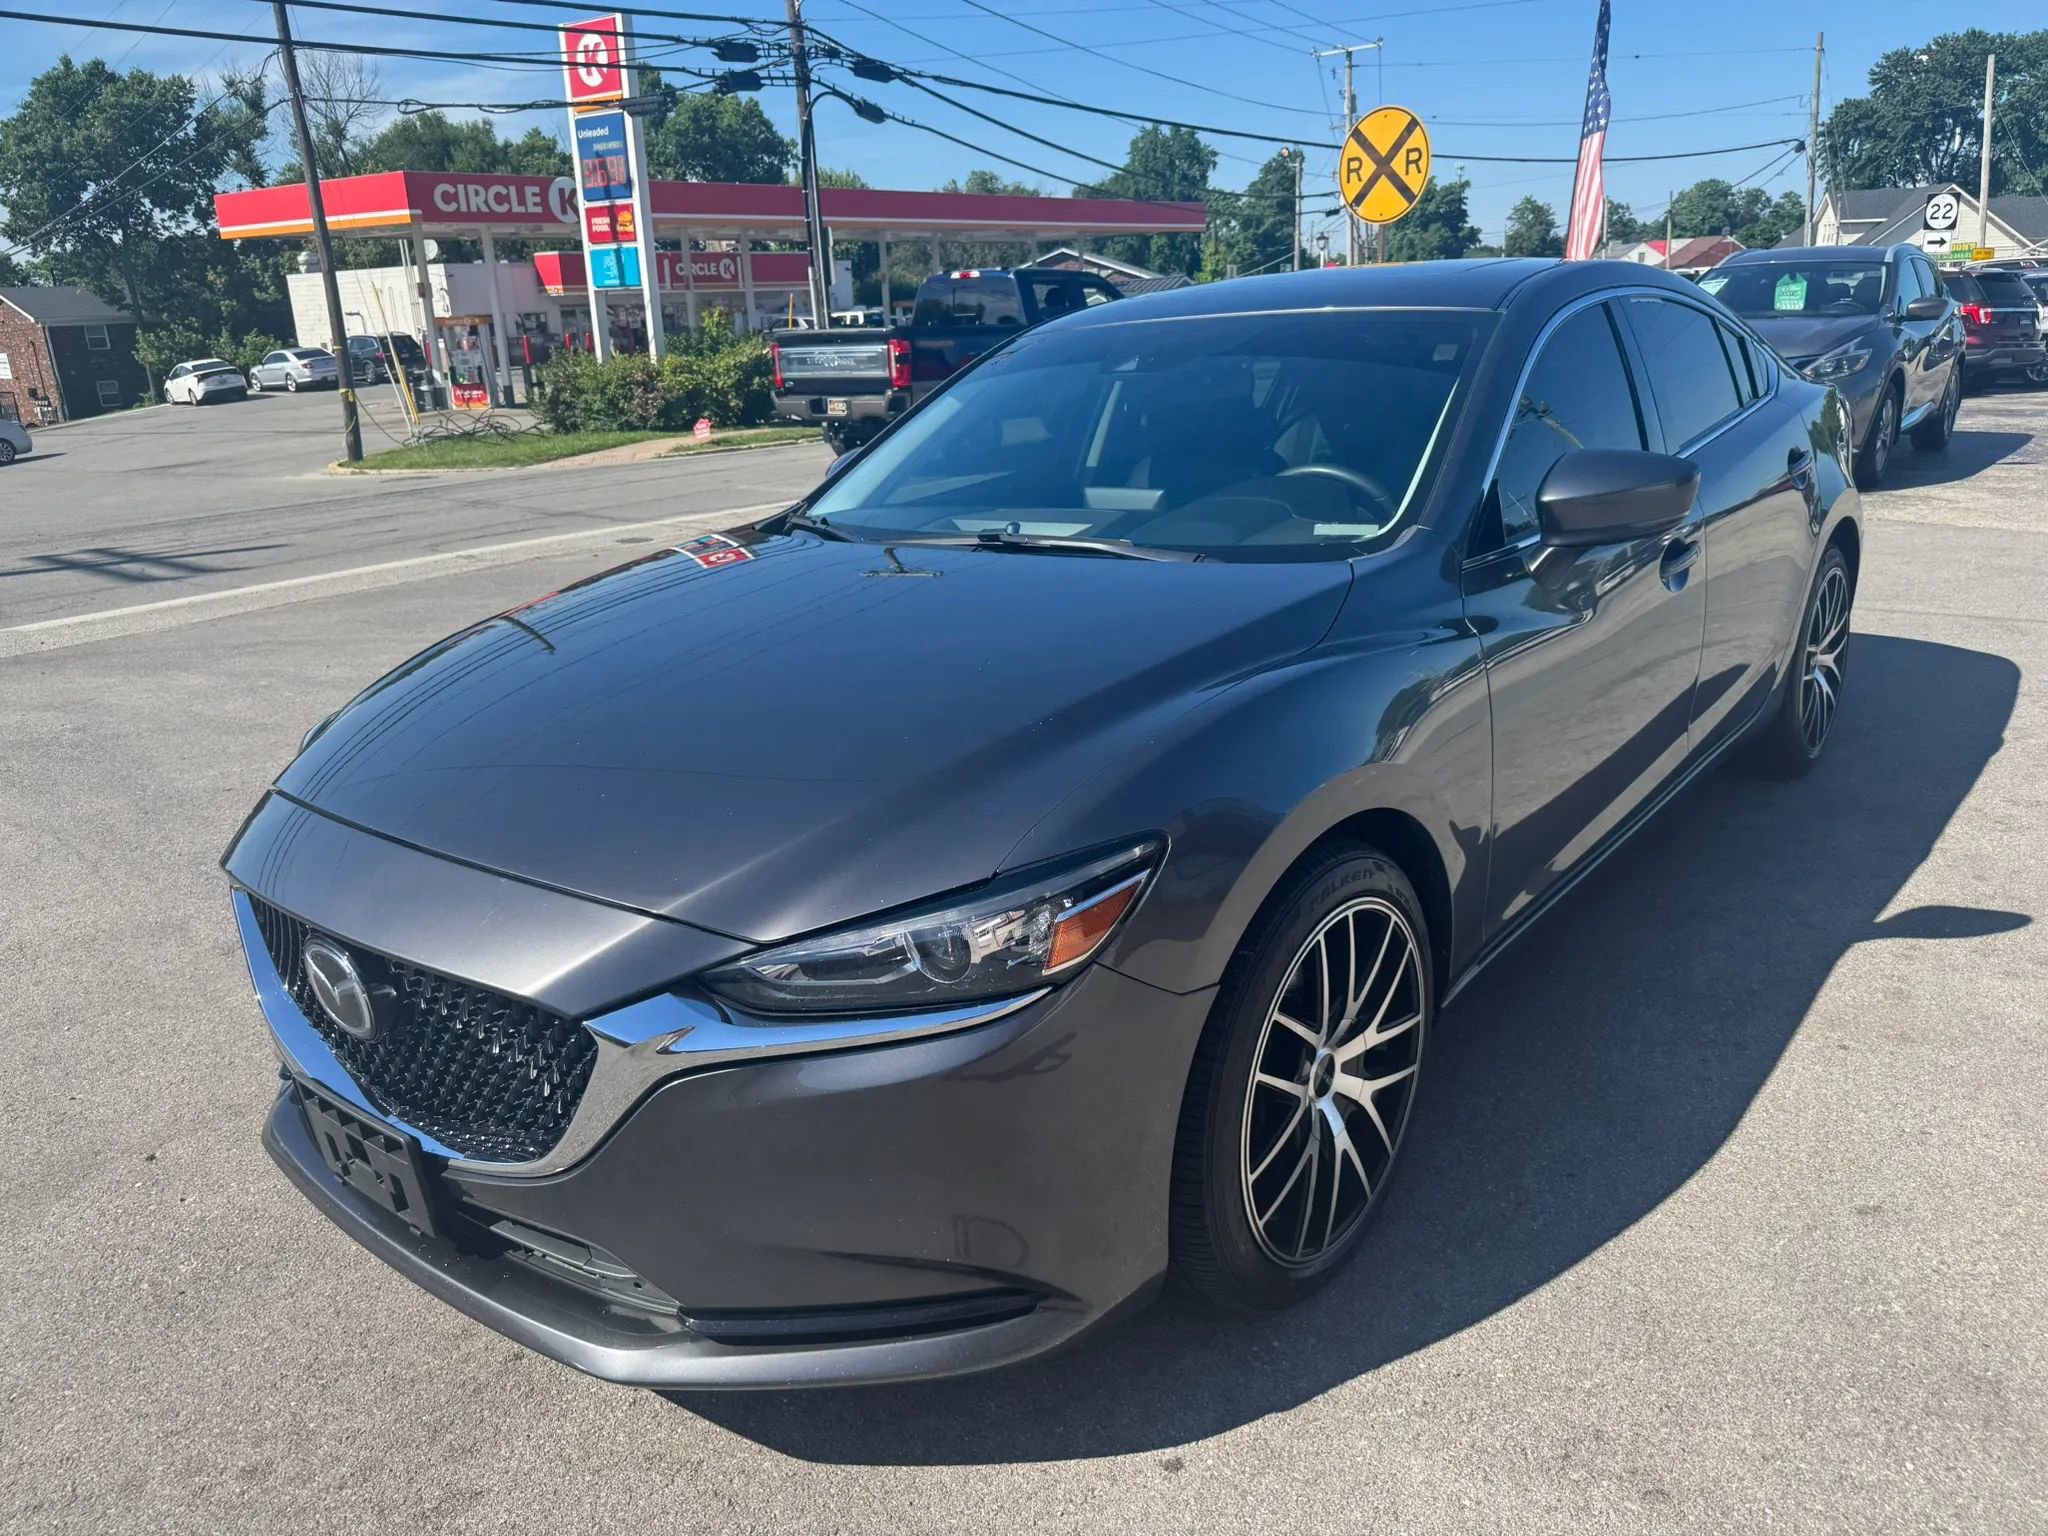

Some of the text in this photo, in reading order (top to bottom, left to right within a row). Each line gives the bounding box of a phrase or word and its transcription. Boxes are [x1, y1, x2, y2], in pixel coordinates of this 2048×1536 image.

[581, 39, 607, 83] K
[577, 126, 609, 139] Unleaded
[1346, 147, 1422, 184] R R
[433, 183, 580, 222] CIRCLE K
[1929, 202, 1954, 220] 22
[591, 216, 610, 226] FRESH
[675, 260, 735, 278] CRCLE K
